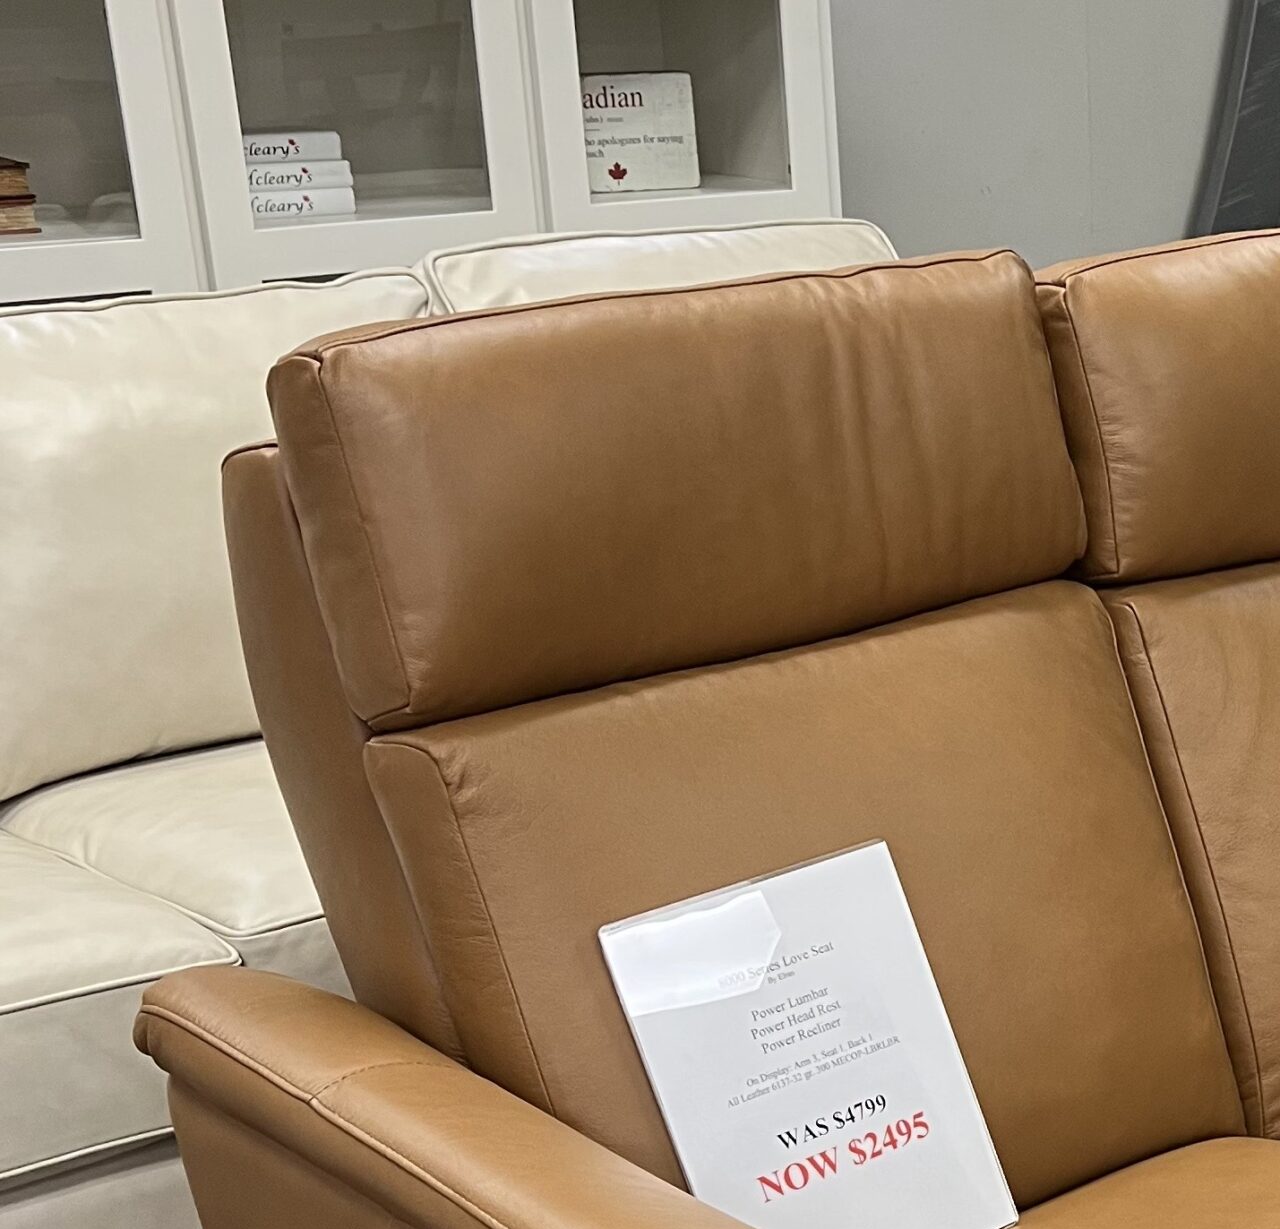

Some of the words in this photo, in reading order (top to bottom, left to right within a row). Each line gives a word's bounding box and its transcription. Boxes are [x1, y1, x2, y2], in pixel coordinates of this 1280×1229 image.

[643, 134, 656, 144] for
[747, 961, 781, 980] Series
[782, 951, 810, 967] Love
[810, 941, 834, 957] Seat
[750, 1021, 785, 1040] Power
[786, 1007, 816, 1027] Head
[817, 1000, 842, 1016] Rest
[751, 1003, 785, 1022] Power
[787, 987, 829, 1009] Lumbar
[761, 1034, 796, 1054] Power
[797, 1018, 841, 1041] Recliner
[746, 1078, 759, 1087] On
[794, 1058, 812, 1070] Arm
[727, 1097, 740, 1108] All
[741, 1086, 770, 1103] Leather
[776, 1117, 830, 1149] WAS
[832, 1094, 886, 1129] $4799
[756, 1147, 838, 1203] NOW
[848, 1111, 930, 1165] $2495
